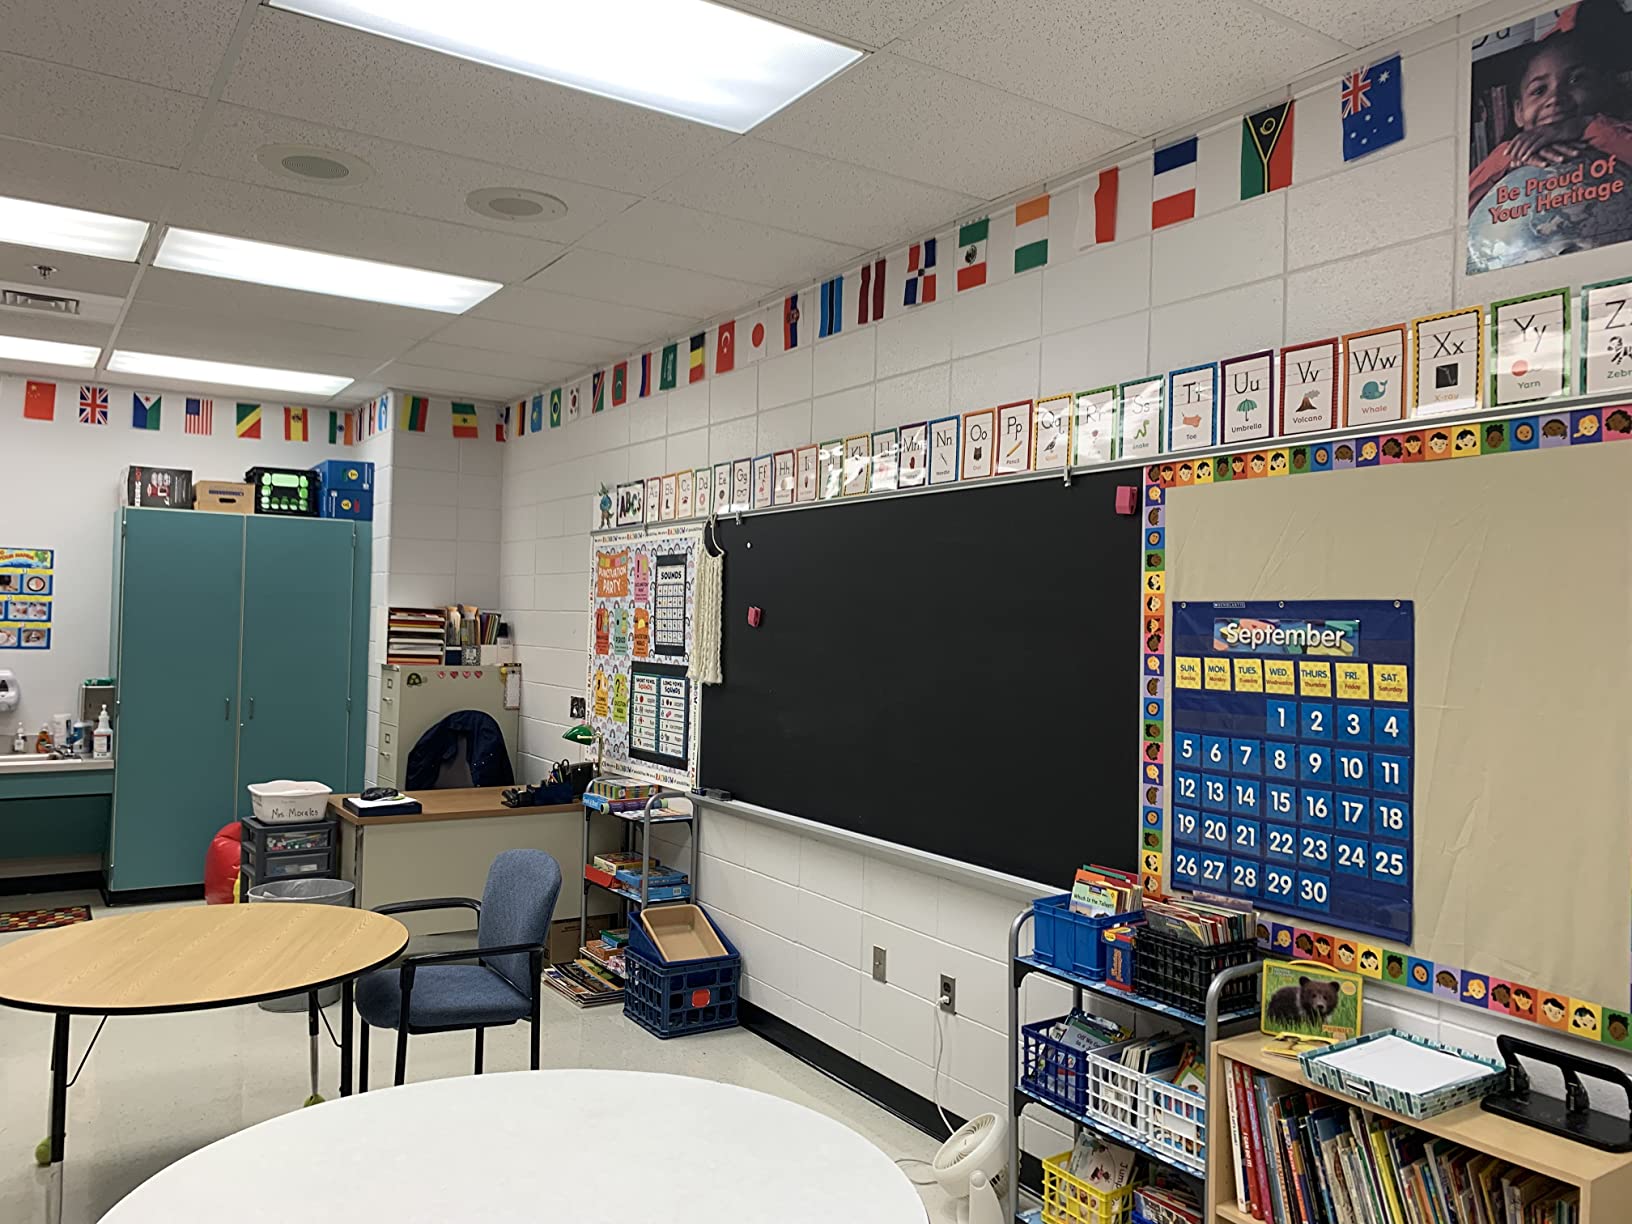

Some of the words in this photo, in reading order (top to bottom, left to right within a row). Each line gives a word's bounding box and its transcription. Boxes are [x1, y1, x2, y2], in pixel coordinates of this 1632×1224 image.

[1497, 185, 1520, 204] Be
[1525, 165, 1584, 197] Proud
[1590, 155, 1617, 178] Of
[1488, 204, 1531, 225] Your
[1536, 179, 1624, 213] Heritage
[1604, 299, 1632, 330] Z
[1513, 314, 1547, 352] Yy
[1433, 331, 1465, 359] Xx
[1353, 348, 1397, 373] Ww
[1297, 361, 1320, 384] Vv
[1607, 368, 1632, 379] Zebr
[1234, 372, 1260, 395] Uu
[1517, 379, 1541, 390] Yarn
[1132, 394, 1150, 414] Ss
[1361, 404, 1388, 414] Whale
[1007, 416, 1022, 440] Pp
[1231, 423, 1262, 434] Umbrella
[1293, 413, 1323, 424] Volcano
[936, 430, 952, 448] Nn
[970, 424, 987, 442] Oo
[736, 468, 748, 484] Gg
[757, 465, 767, 479] Ff
[779, 461, 790, 475] Hh
[698, 477, 708, 490] Dd
[718, 472, 727, 486] Ee
[619, 491, 643, 519] ABC's
[661, 571, 682, 580] SOUNDS
[602, 578, 622, 595] PARTY
[1226, 623, 1345, 650] September
[1180, 664, 1197, 673] SUN.
[1208, 665, 1227, 674] MON.
[1238, 666, 1258, 675] TUES.
[1269, 668, 1289, 677] WED.
[1301, 670, 1330, 680] THURS.
[1344, 671, 1360, 681] FRI.
[1380, 673, 1400, 683] SAT.
[1277, 708, 1286, 727] 1
[1310, 710, 1323, 731] 2
[1346, 713, 1360, 735] 3
[1384, 716, 1399, 737] 4
[1182, 739, 1193, 758] 5
[1210, 743, 1221, 762] 6
[1240, 746, 1252, 765] 7
[1274, 750, 1286, 770] 8
[1309, 753, 1321, 773] 9
[1341, 757, 1364, 778] 10
[1382, 762, 1399, 784] 11
[1179, 777, 1195, 798] 12
[1206, 780, 1224, 802] 13
[1236, 785, 1255, 807] 14
[1271, 790, 1291, 812] 15
[1307, 796, 1328, 818] 16
[1342, 801, 1363, 823] 17
[1379, 807, 1403, 830] 18
[1178, 813, 1195, 835] 19
[1204, 819, 1226, 841] 20
[1236, 825, 1255, 847] 21
[1269, 831, 1293, 855] 22
[1302, 836, 1327, 860] 23
[1338, 843, 1365, 868] 24
[1375, 851, 1404, 874] 25
[1176, 855, 1197, 876] 26
[1203, 861, 1224, 881] 27
[1233, 866, 1257, 887] 28
[1267, 872, 1292, 895] 29
[1301, 878, 1327, 903] 30
[1074, 893, 1086, 901] Which
